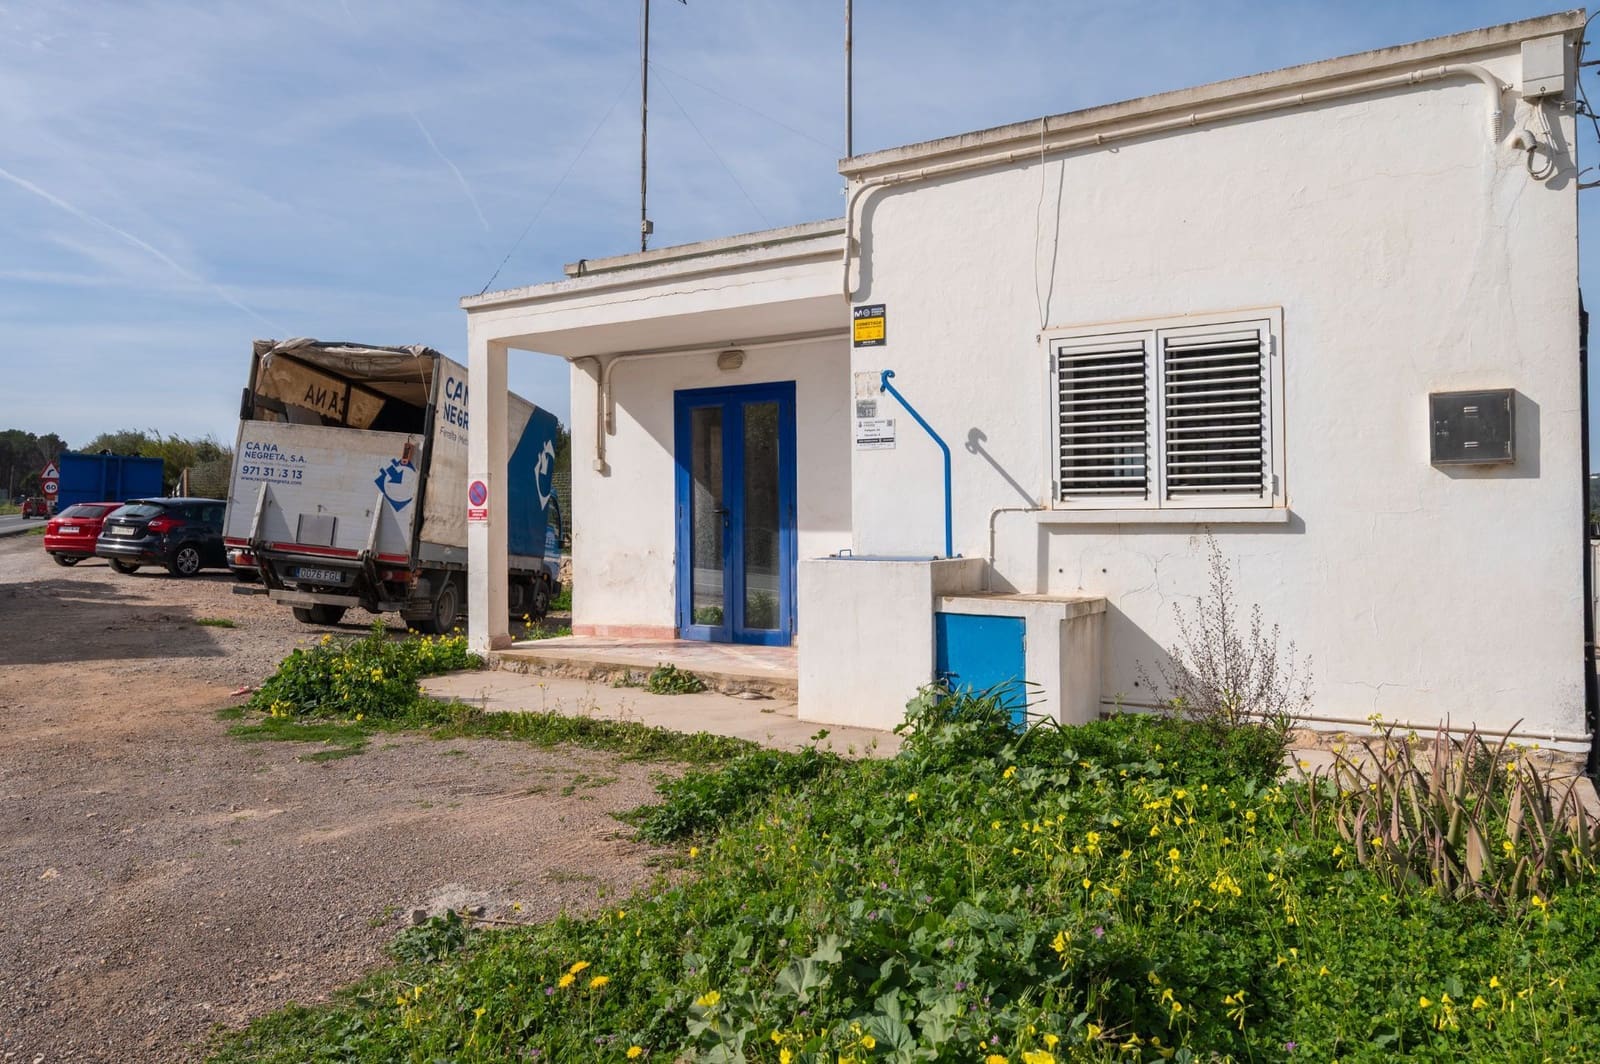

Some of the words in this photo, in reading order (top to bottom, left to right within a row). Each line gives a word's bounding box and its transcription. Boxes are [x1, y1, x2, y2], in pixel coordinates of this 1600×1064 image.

[244, 451, 288, 462] NEGRETA,
[290, 455, 307, 464] S.A.
[242, 465, 260, 476] 971
[263, 467, 274, 477] 31
[292, 470, 303, 480] 13
